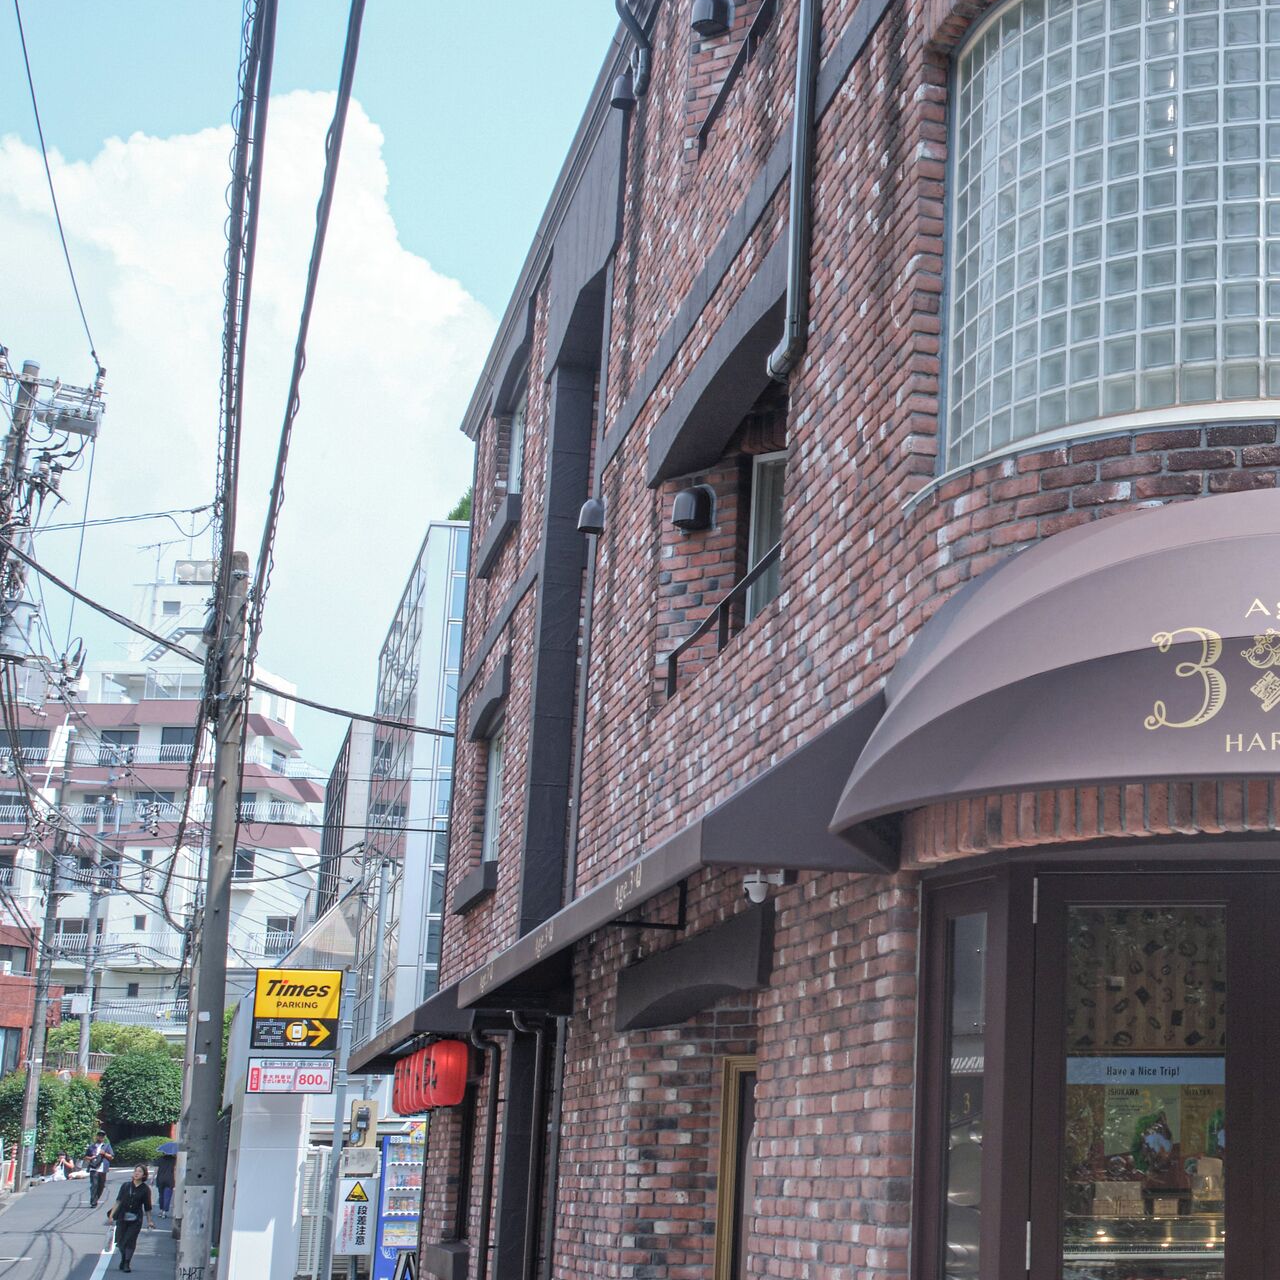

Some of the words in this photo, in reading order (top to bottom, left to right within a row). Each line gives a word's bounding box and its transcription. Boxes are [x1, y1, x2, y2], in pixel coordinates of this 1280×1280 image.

[1143, 626, 1228, 731] 3
[266, 979, 332, 998] Times
[276, 1000, 319, 1009] PARKING
[1106, 1066, 1127, 1076] Have
[1130, 1068, 1135, 1076] a
[1138, 1066, 1157, 1076] Nice
[1160, 1066, 1180, 1078] Trip!
[355, 1205, 368, 1246] 段差注意
